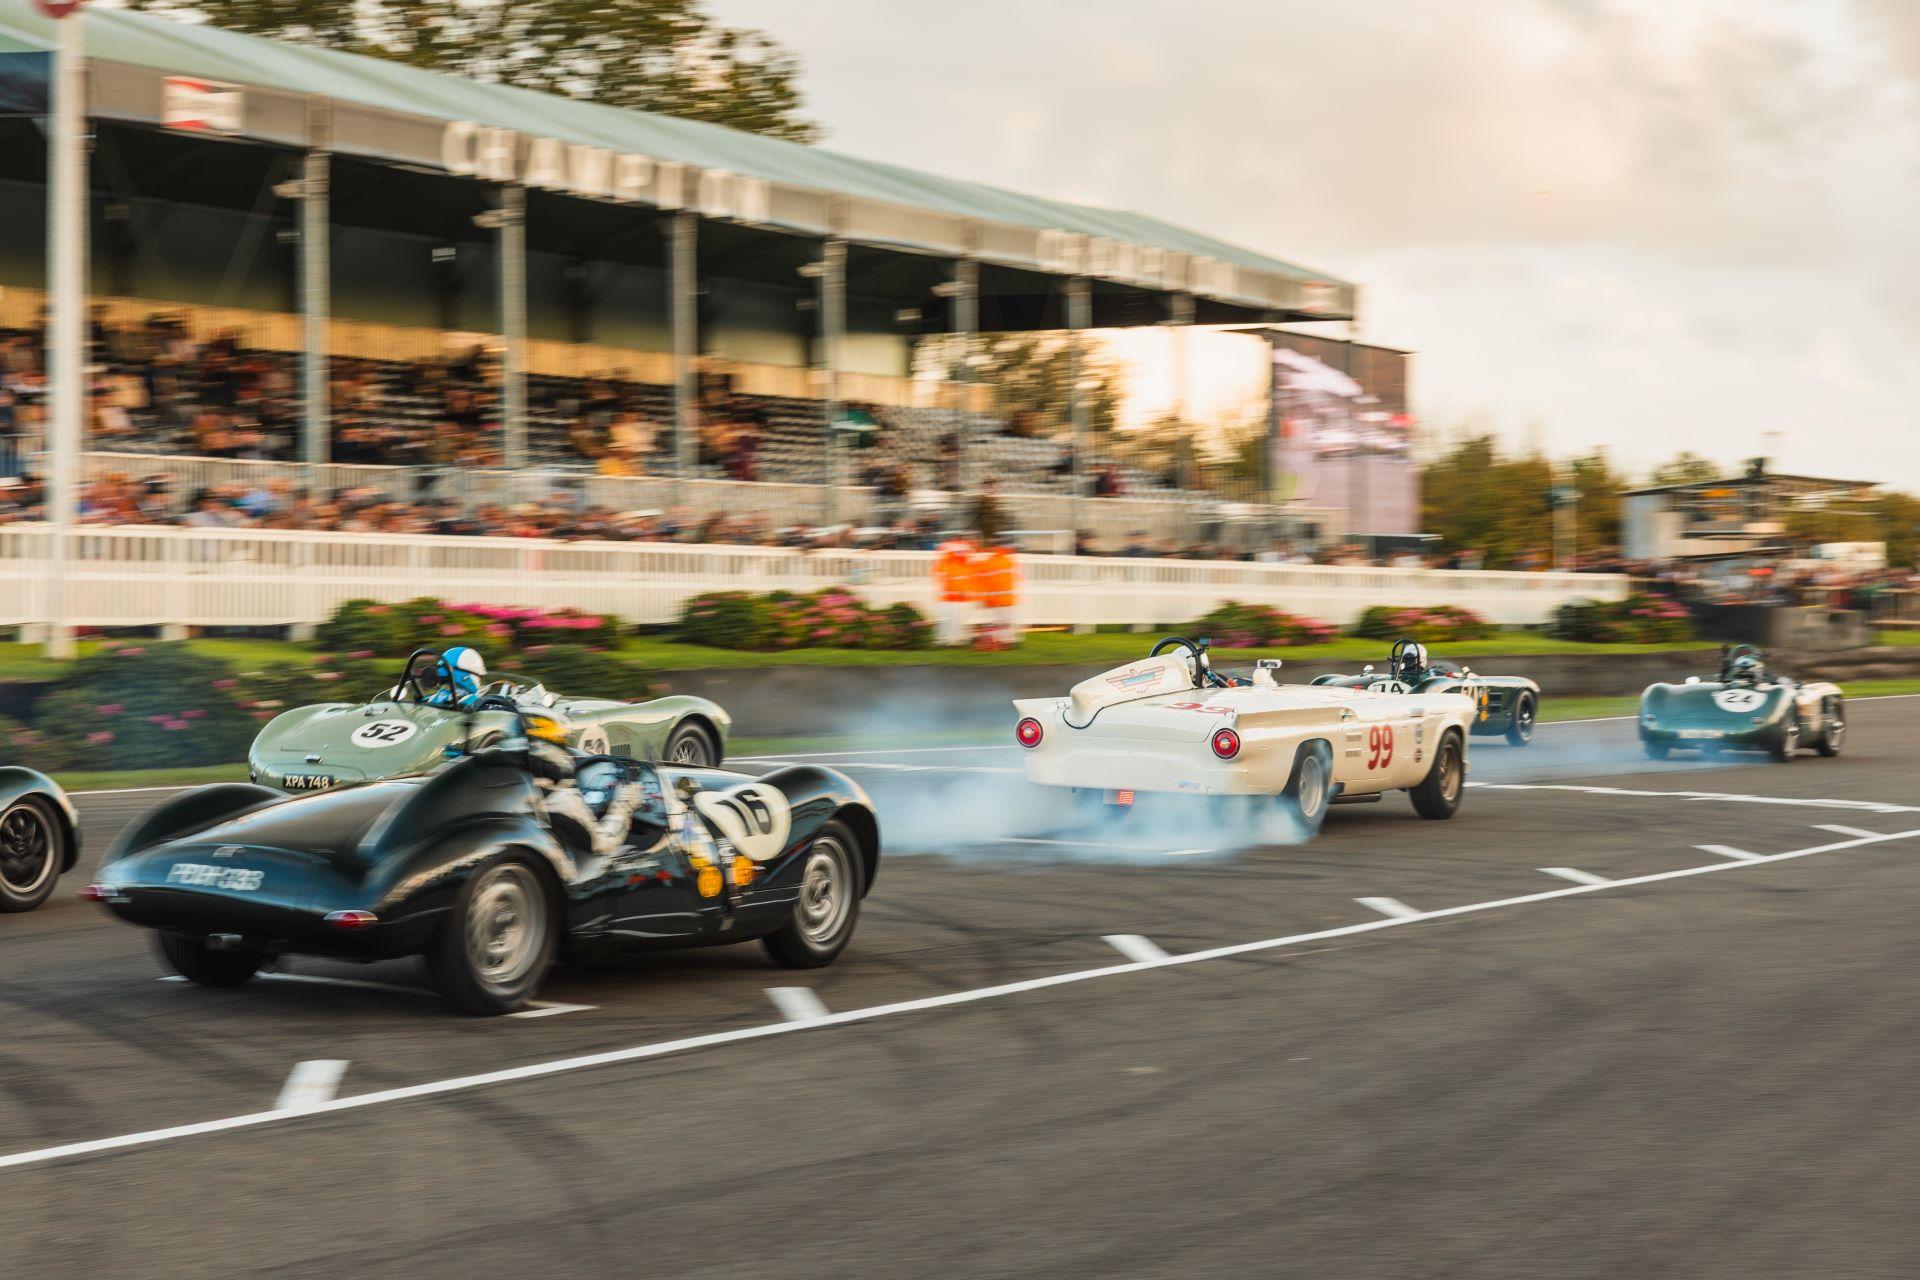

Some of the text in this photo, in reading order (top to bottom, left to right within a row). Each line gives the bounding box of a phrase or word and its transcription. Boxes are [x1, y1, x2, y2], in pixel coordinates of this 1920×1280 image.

[361, 723, 409, 741] 52
[1368, 725, 1393, 770] 99
[285, 775, 330, 789] XPA 748
[714, 789, 772, 837] 16
